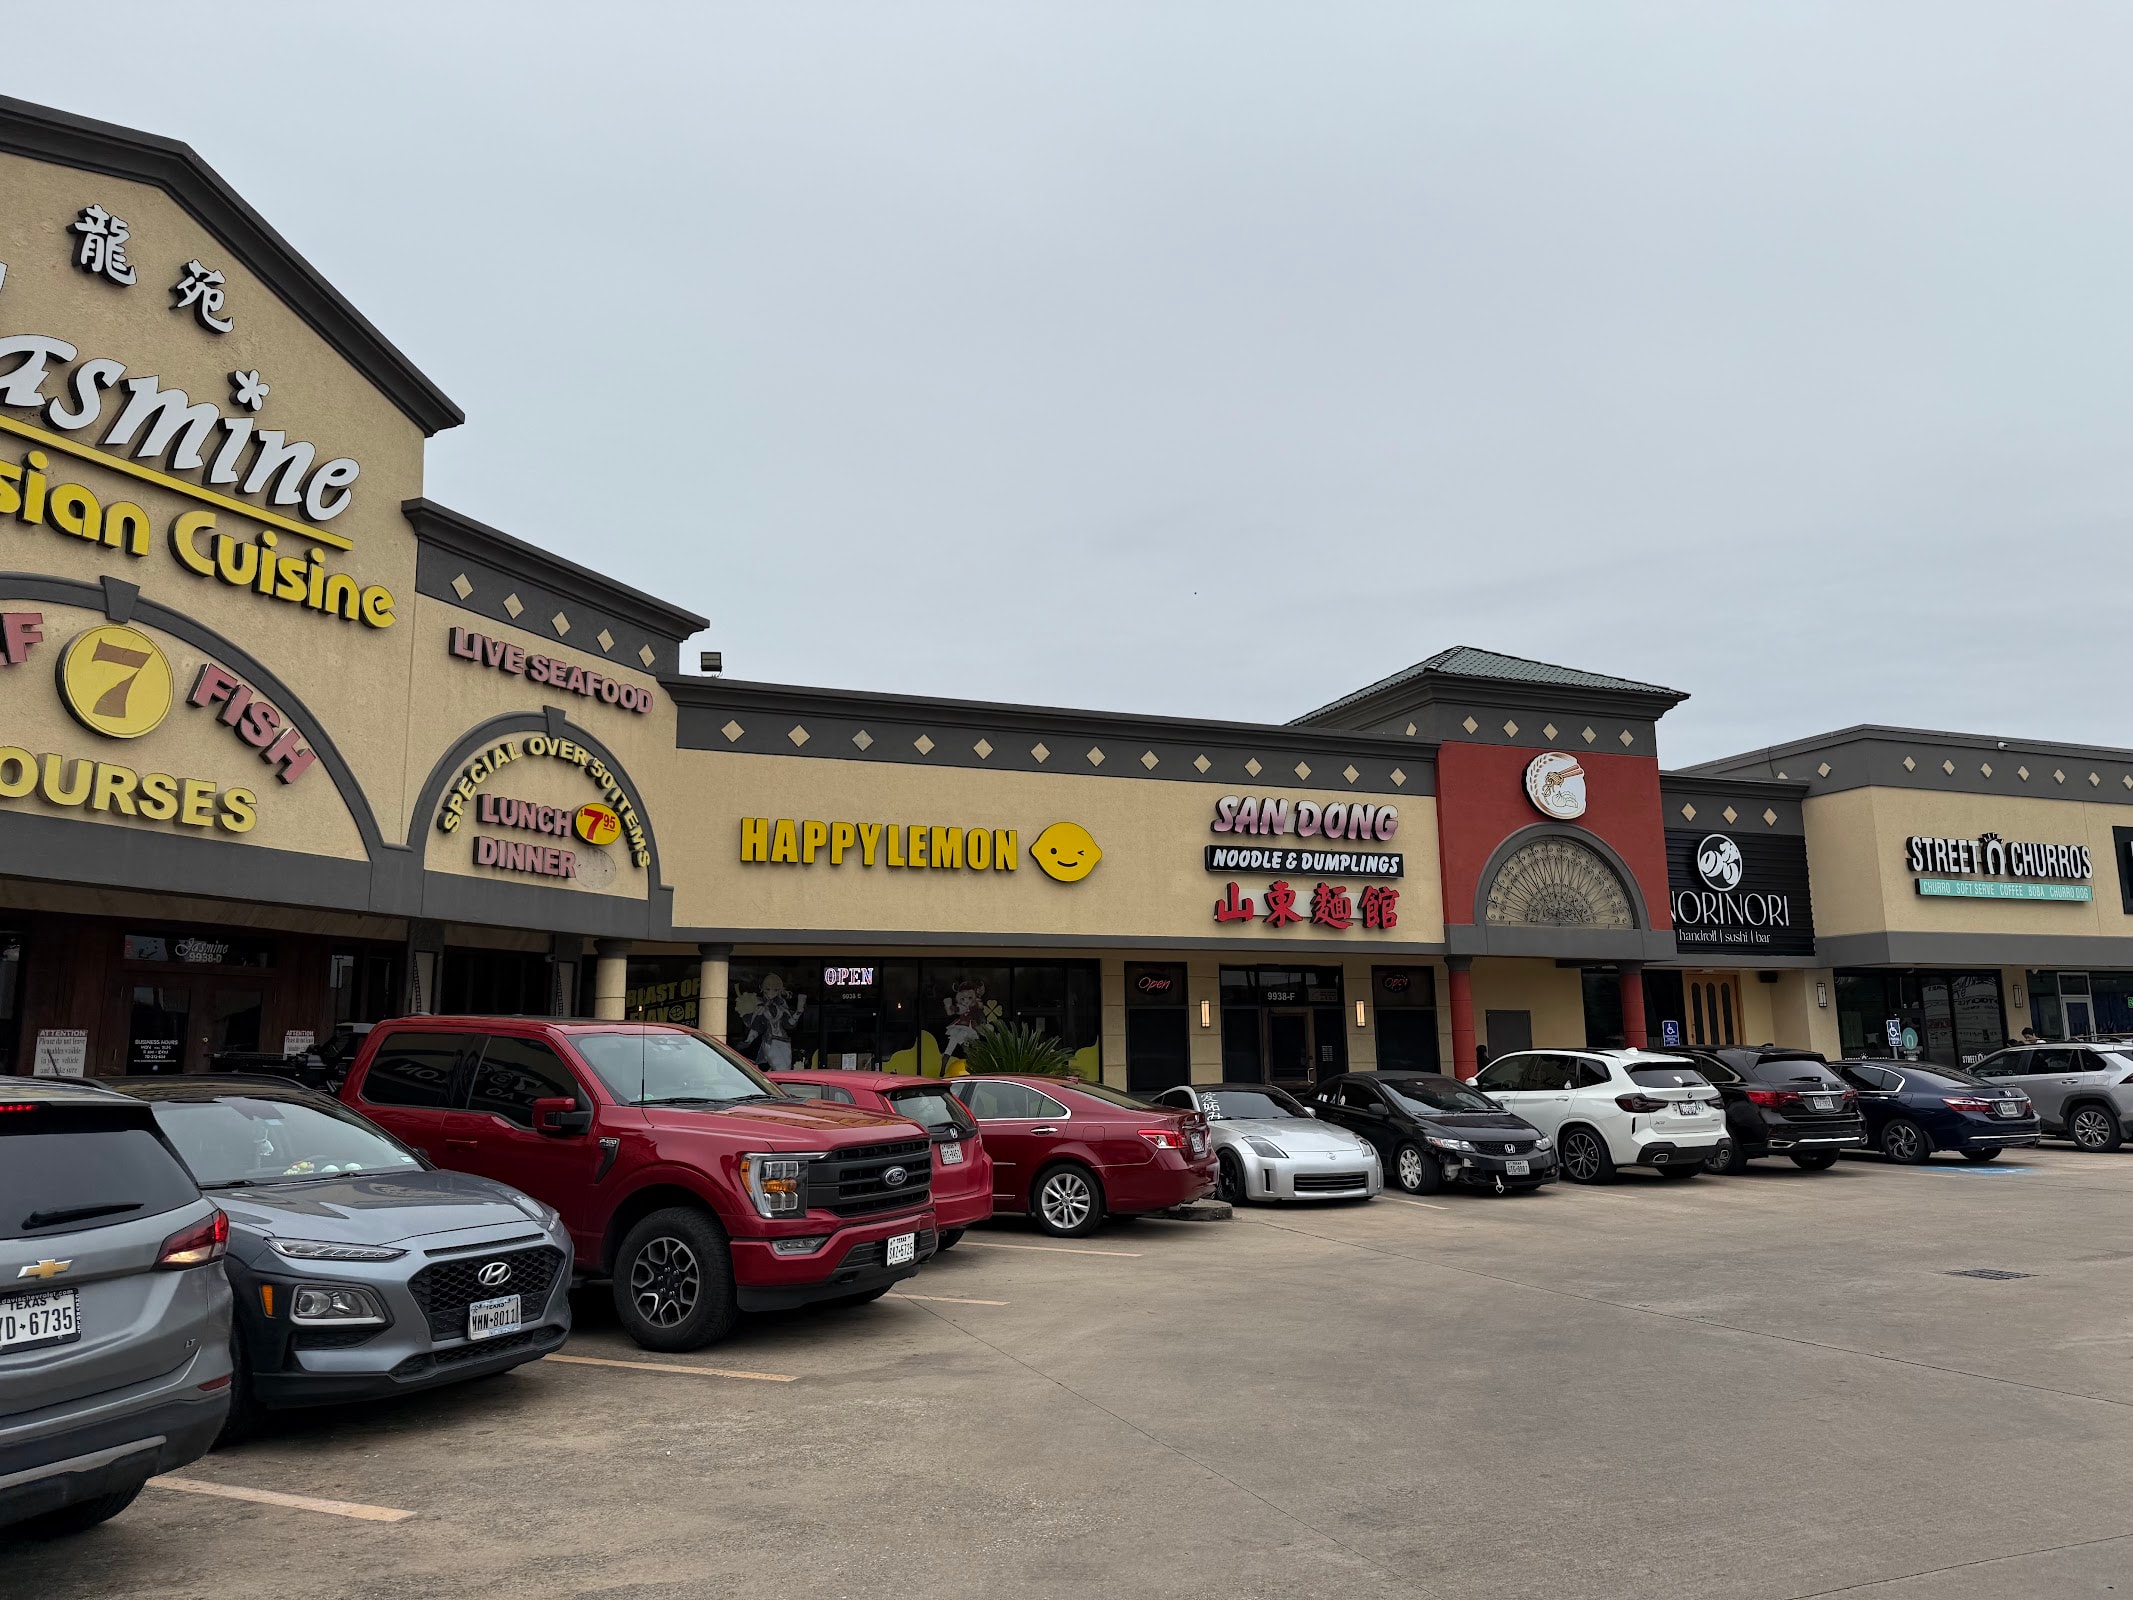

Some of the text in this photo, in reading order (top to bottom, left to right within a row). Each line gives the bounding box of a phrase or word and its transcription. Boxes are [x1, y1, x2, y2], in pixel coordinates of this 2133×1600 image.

[0, 333, 361, 522] asmine
[168, 510, 397, 629] Cuisine
[0, 612, 44, 667] F
[91, 637, 154, 719] 7
[449, 626, 654, 714] LIVE SEAFOOD
[186, 662, 317, 785] FISH
[0, 745, 258, 833] OURSES
[437, 736, 651, 868] SPECIAL OVER 50 ITEMS
[477, 793, 573, 838] LUNCH
[1210, 795, 1399, 842] SAN DONG
[473, 836, 577, 879] DINNER
[1212, 848, 1400, 874] NOODLE & DUMPLINGS
[1908, 835, 1980, 874] STREET
[2007, 841, 2093, 879] CHURROS
[1923, 881, 2089, 899] CHURRO SOFT SERVE COFFEE BOBA CHURRO DOG
[175, 937, 229, 957] Jasmine
[1679, 929, 1771, 943] handroll sushi bar
[189, 952, 223, 964] 9938-D
[824, 967, 874, 986] OPEN
[1138, 976, 1171, 992] Open
[1267, 991, 1296, 1001] 9938-F
[10, 1298, 47, 1311] TEXAS
[29, 1306, 73, 1336] 6735
